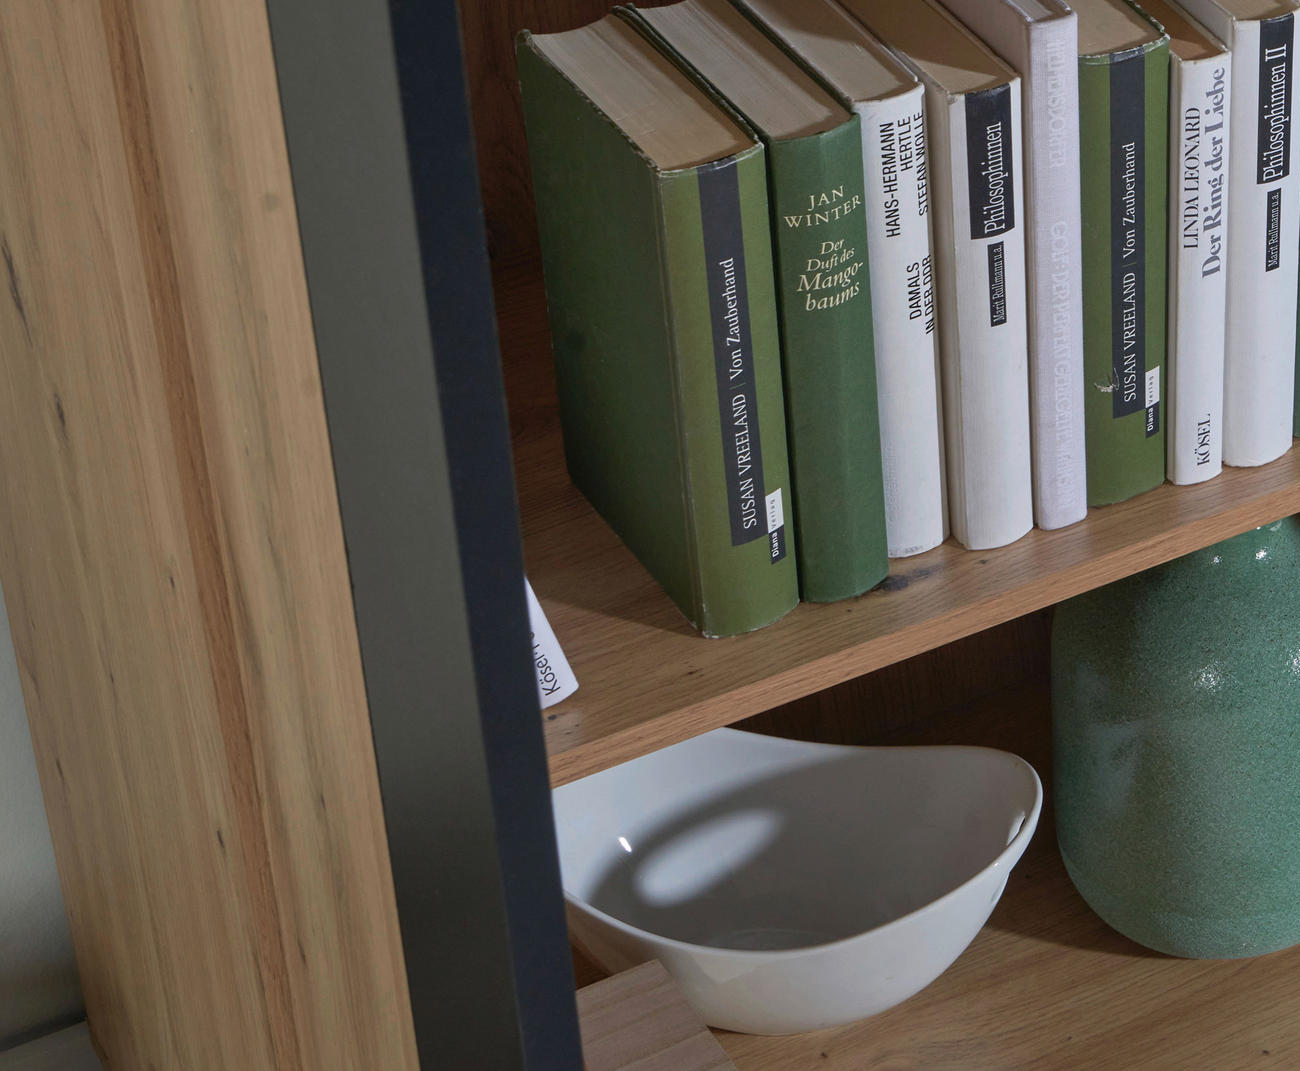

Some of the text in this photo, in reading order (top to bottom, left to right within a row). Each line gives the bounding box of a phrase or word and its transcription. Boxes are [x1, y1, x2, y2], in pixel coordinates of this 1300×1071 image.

[1262, 43, 1289, 183] Philosophinnen II
[897, 116, 913, 172] HERTLE
[879, 121, 901, 238] HANS-HERMANN
[916, 162, 928, 216] STEFAN
[982, 121, 1009, 235] Philosophinnen
[1183, 107, 1200, 249] LINDA LEONARD
[1201, 66, 1225, 278] Der Ring der Liebe
[784, 194, 861, 228] WINTER
[808, 185, 844, 211] JAN
[806, 247, 855, 272] Duft des
[820, 239, 845, 255] Der
[1267, 245, 1279, 268] Marit
[796, 262, 864, 292] Mango-
[906, 262, 922, 320] DAMALS
[1122, 141, 1137, 403] SUSAN VREELAND Von Zauberhand
[805, 281, 860, 311] baums
[923, 287, 933, 317] DER
[992, 300, 1005, 324] Marit
[925, 317, 935, 335] IN
[719, 257, 757, 530] SUSAN VREELAND Von Zauberhand
[1194, 413, 1211, 466] KÖSEL
[771, 531, 779, 558] Diana
